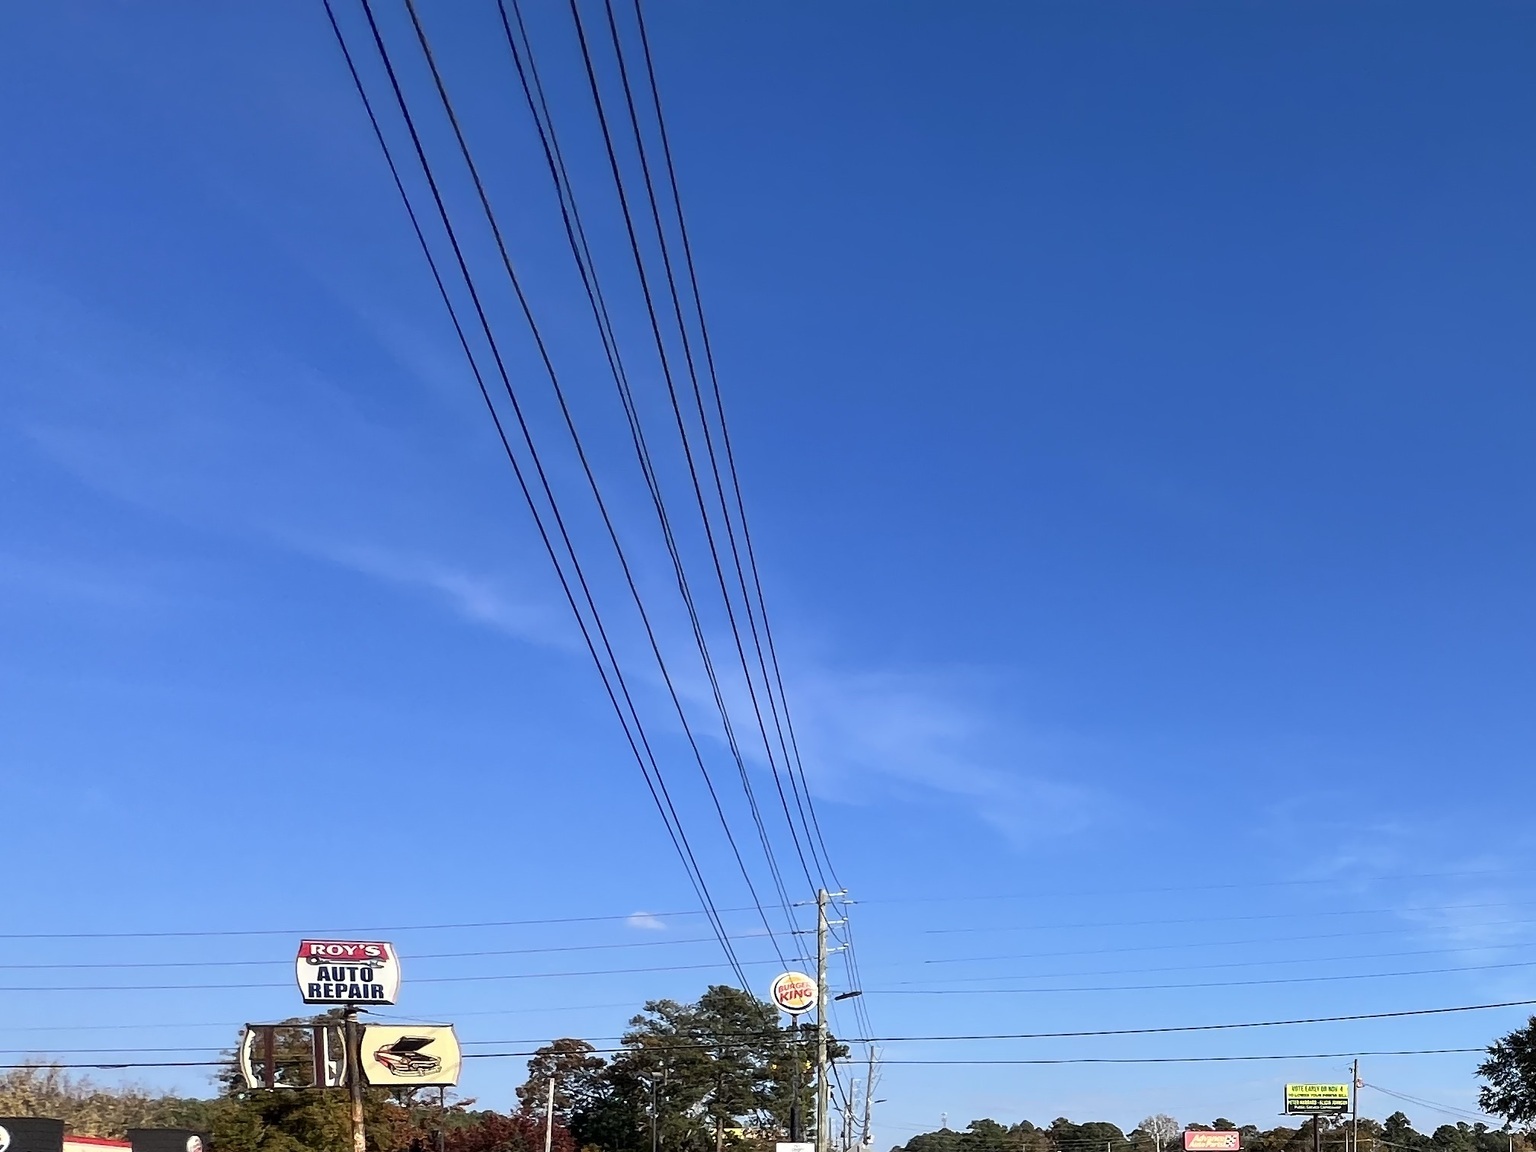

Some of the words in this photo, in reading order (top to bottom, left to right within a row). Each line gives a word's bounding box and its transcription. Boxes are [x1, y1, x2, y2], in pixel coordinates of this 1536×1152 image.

[310, 944, 381, 956] ROY'S
[317, 966, 374, 982] AUTO
[308, 983, 385, 999] REPAIR
[778, 982, 811, 993] BURGER
[780, 989, 812, 1003] KING
